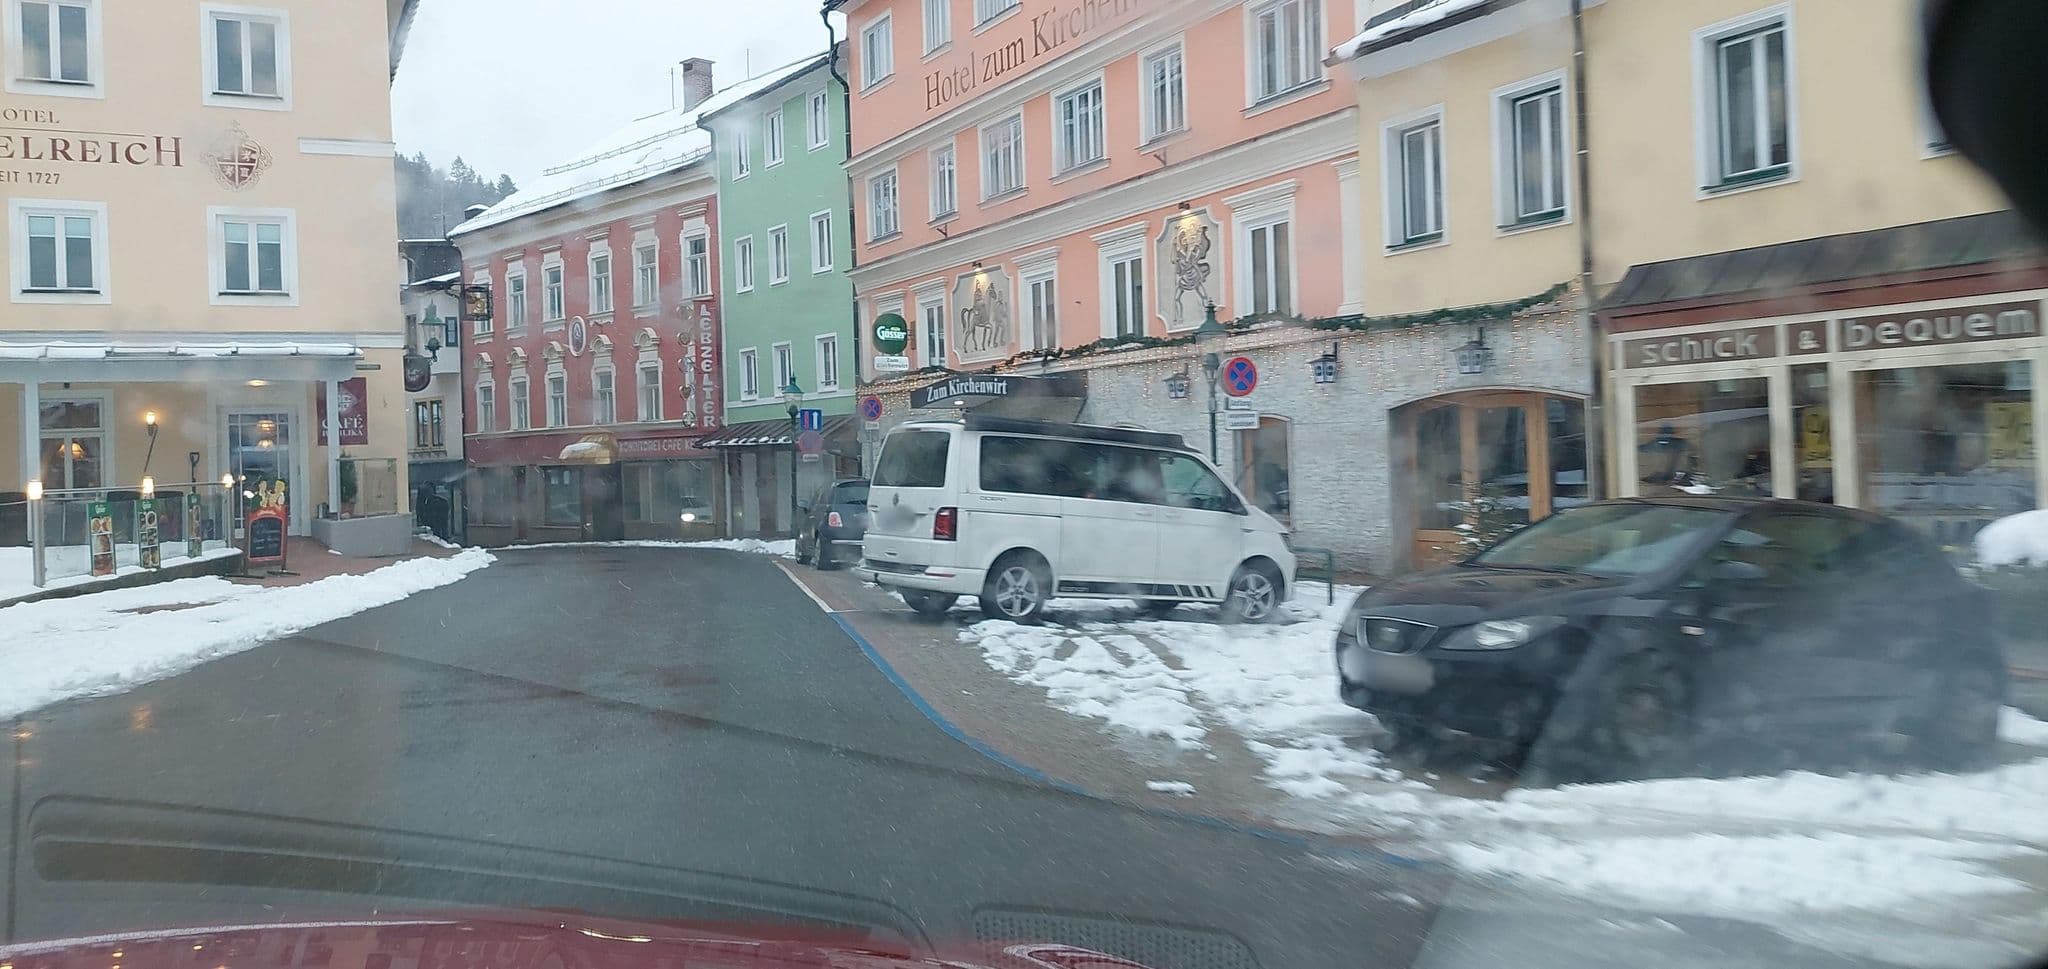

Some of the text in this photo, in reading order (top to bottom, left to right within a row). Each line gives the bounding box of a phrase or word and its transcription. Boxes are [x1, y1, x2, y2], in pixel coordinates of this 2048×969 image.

[924, 51, 977, 112] Hotel
[982, 37, 1026, 83] zum
[3, 107, 61, 124] OTEL
[0, 135, 184, 168] ELREICH
[27, 172, 61, 185] 1727
[876, 325, 907, 341] Gösser
[1640, 307, 2037, 365] schick & bequem
[700, 303, 716, 428] LEBZELTER
[926, 377, 1008, 402] Zum Kirchenwirt
[322, 415, 364, 429] CFÉ
